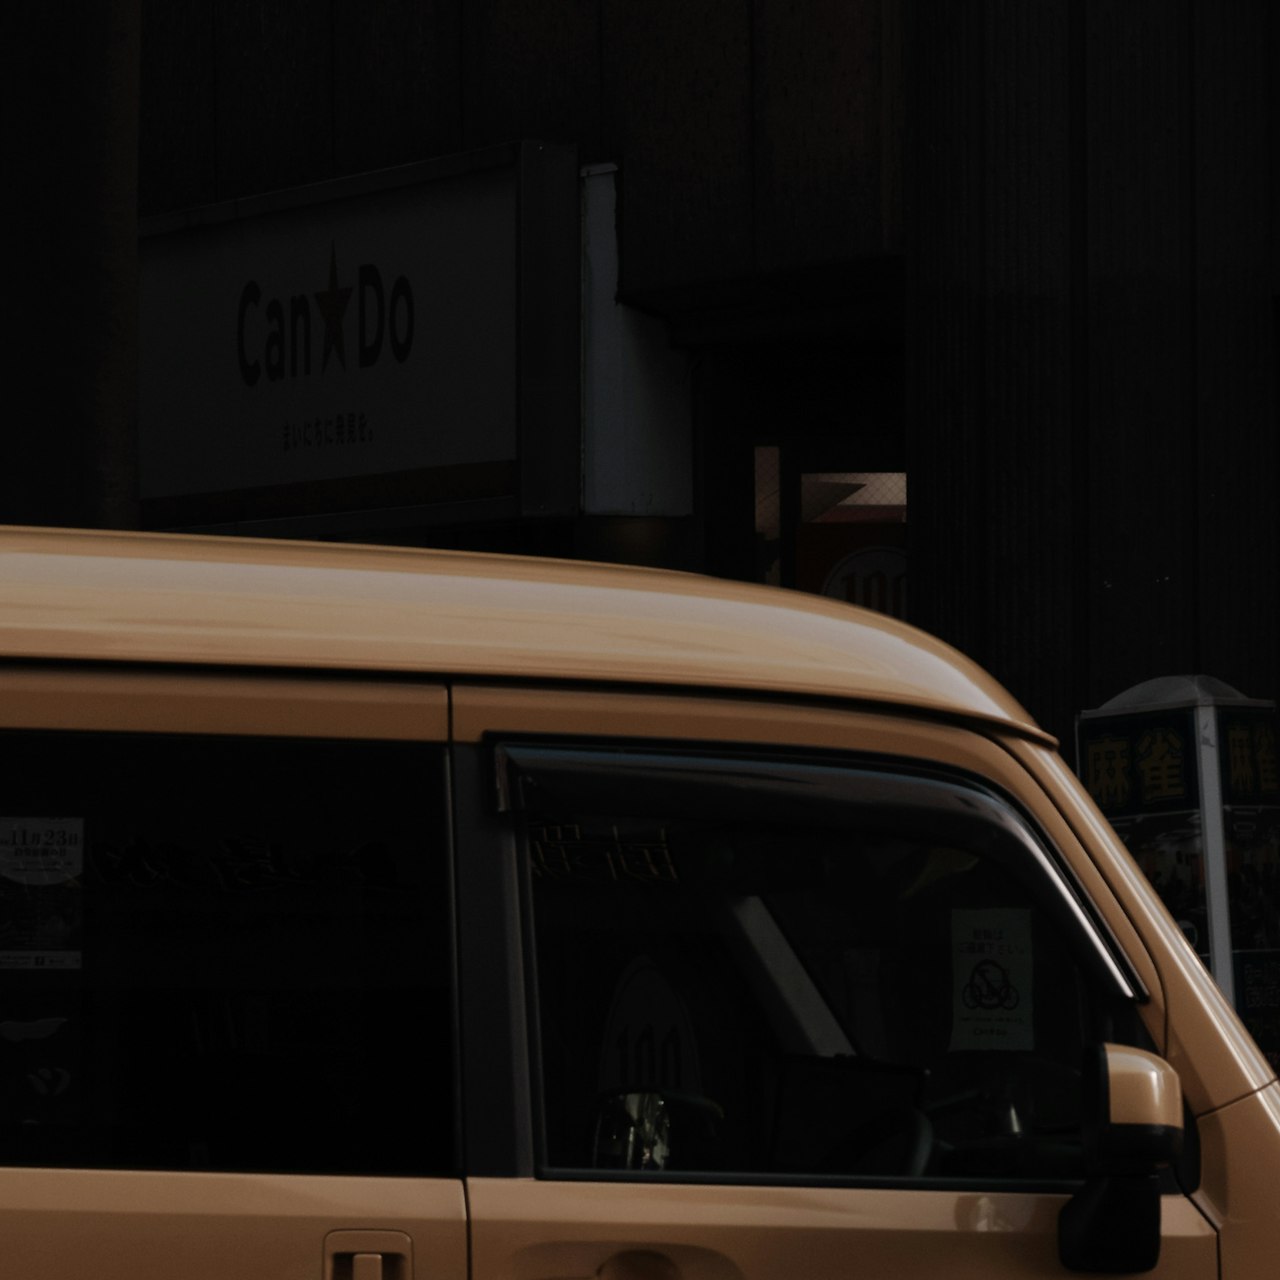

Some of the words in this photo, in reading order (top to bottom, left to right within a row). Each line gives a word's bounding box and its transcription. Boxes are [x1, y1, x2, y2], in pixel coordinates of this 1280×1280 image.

[237, 280, 312, 387] Can
[357, 263, 415, 369] Do
[1087, 726, 1185, 807] 麻雀
